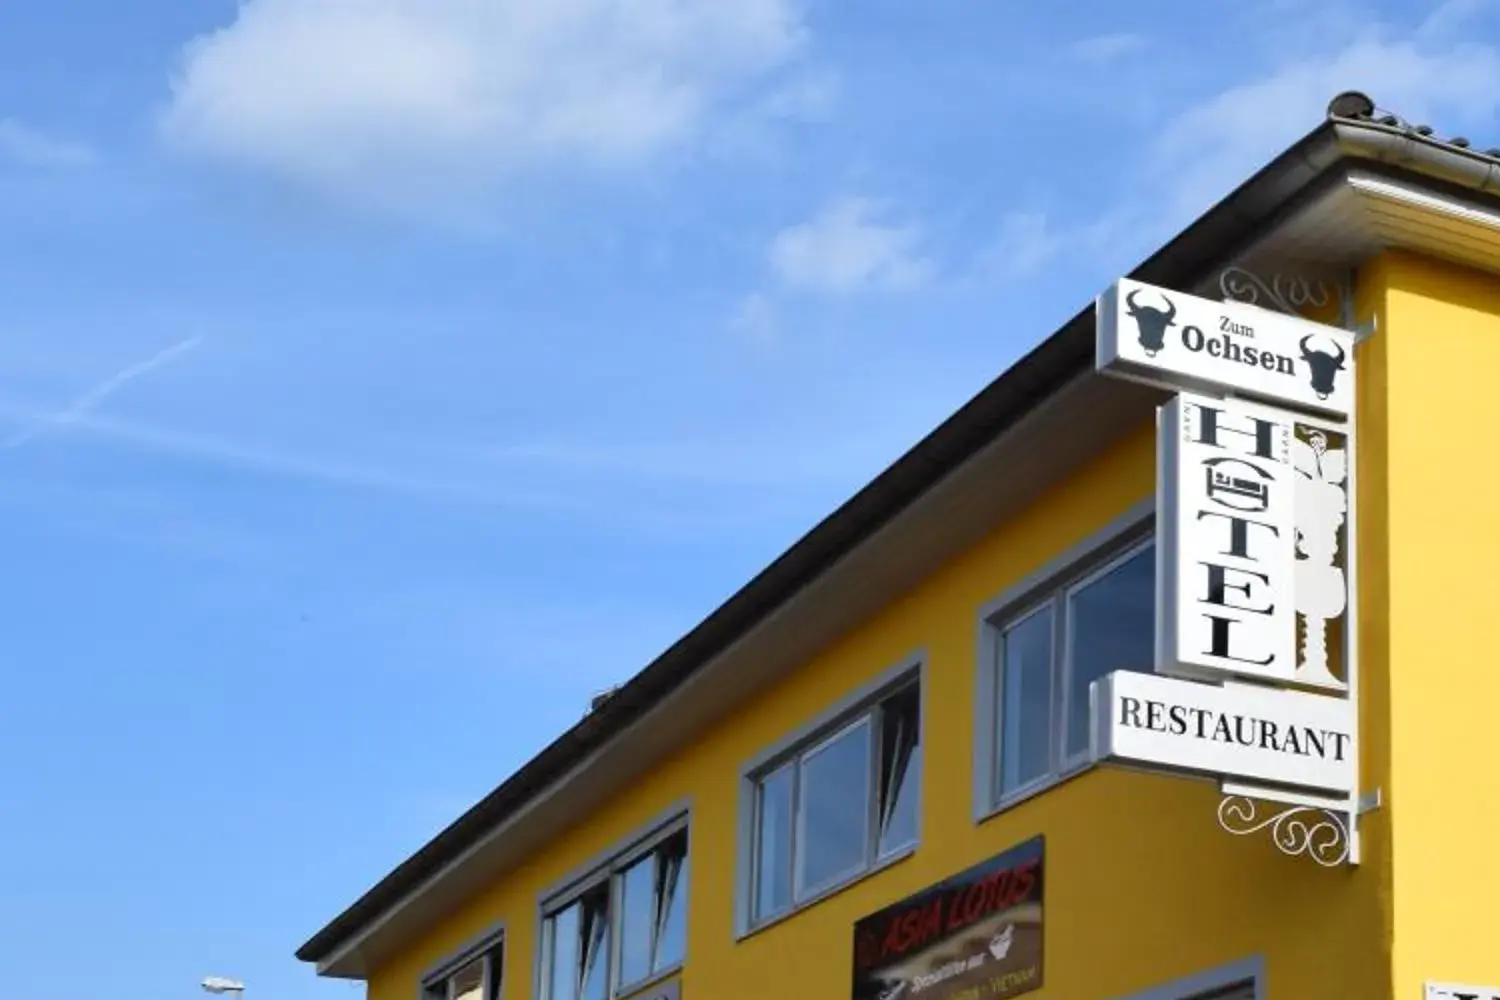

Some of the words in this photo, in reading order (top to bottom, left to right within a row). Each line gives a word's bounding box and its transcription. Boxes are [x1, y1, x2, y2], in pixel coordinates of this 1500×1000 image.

[1181, 325, 1296, 376] Ochsen
[1218, 315, 1254, 338] Zum
[1118, 696, 1351, 762] RESTAURANT
